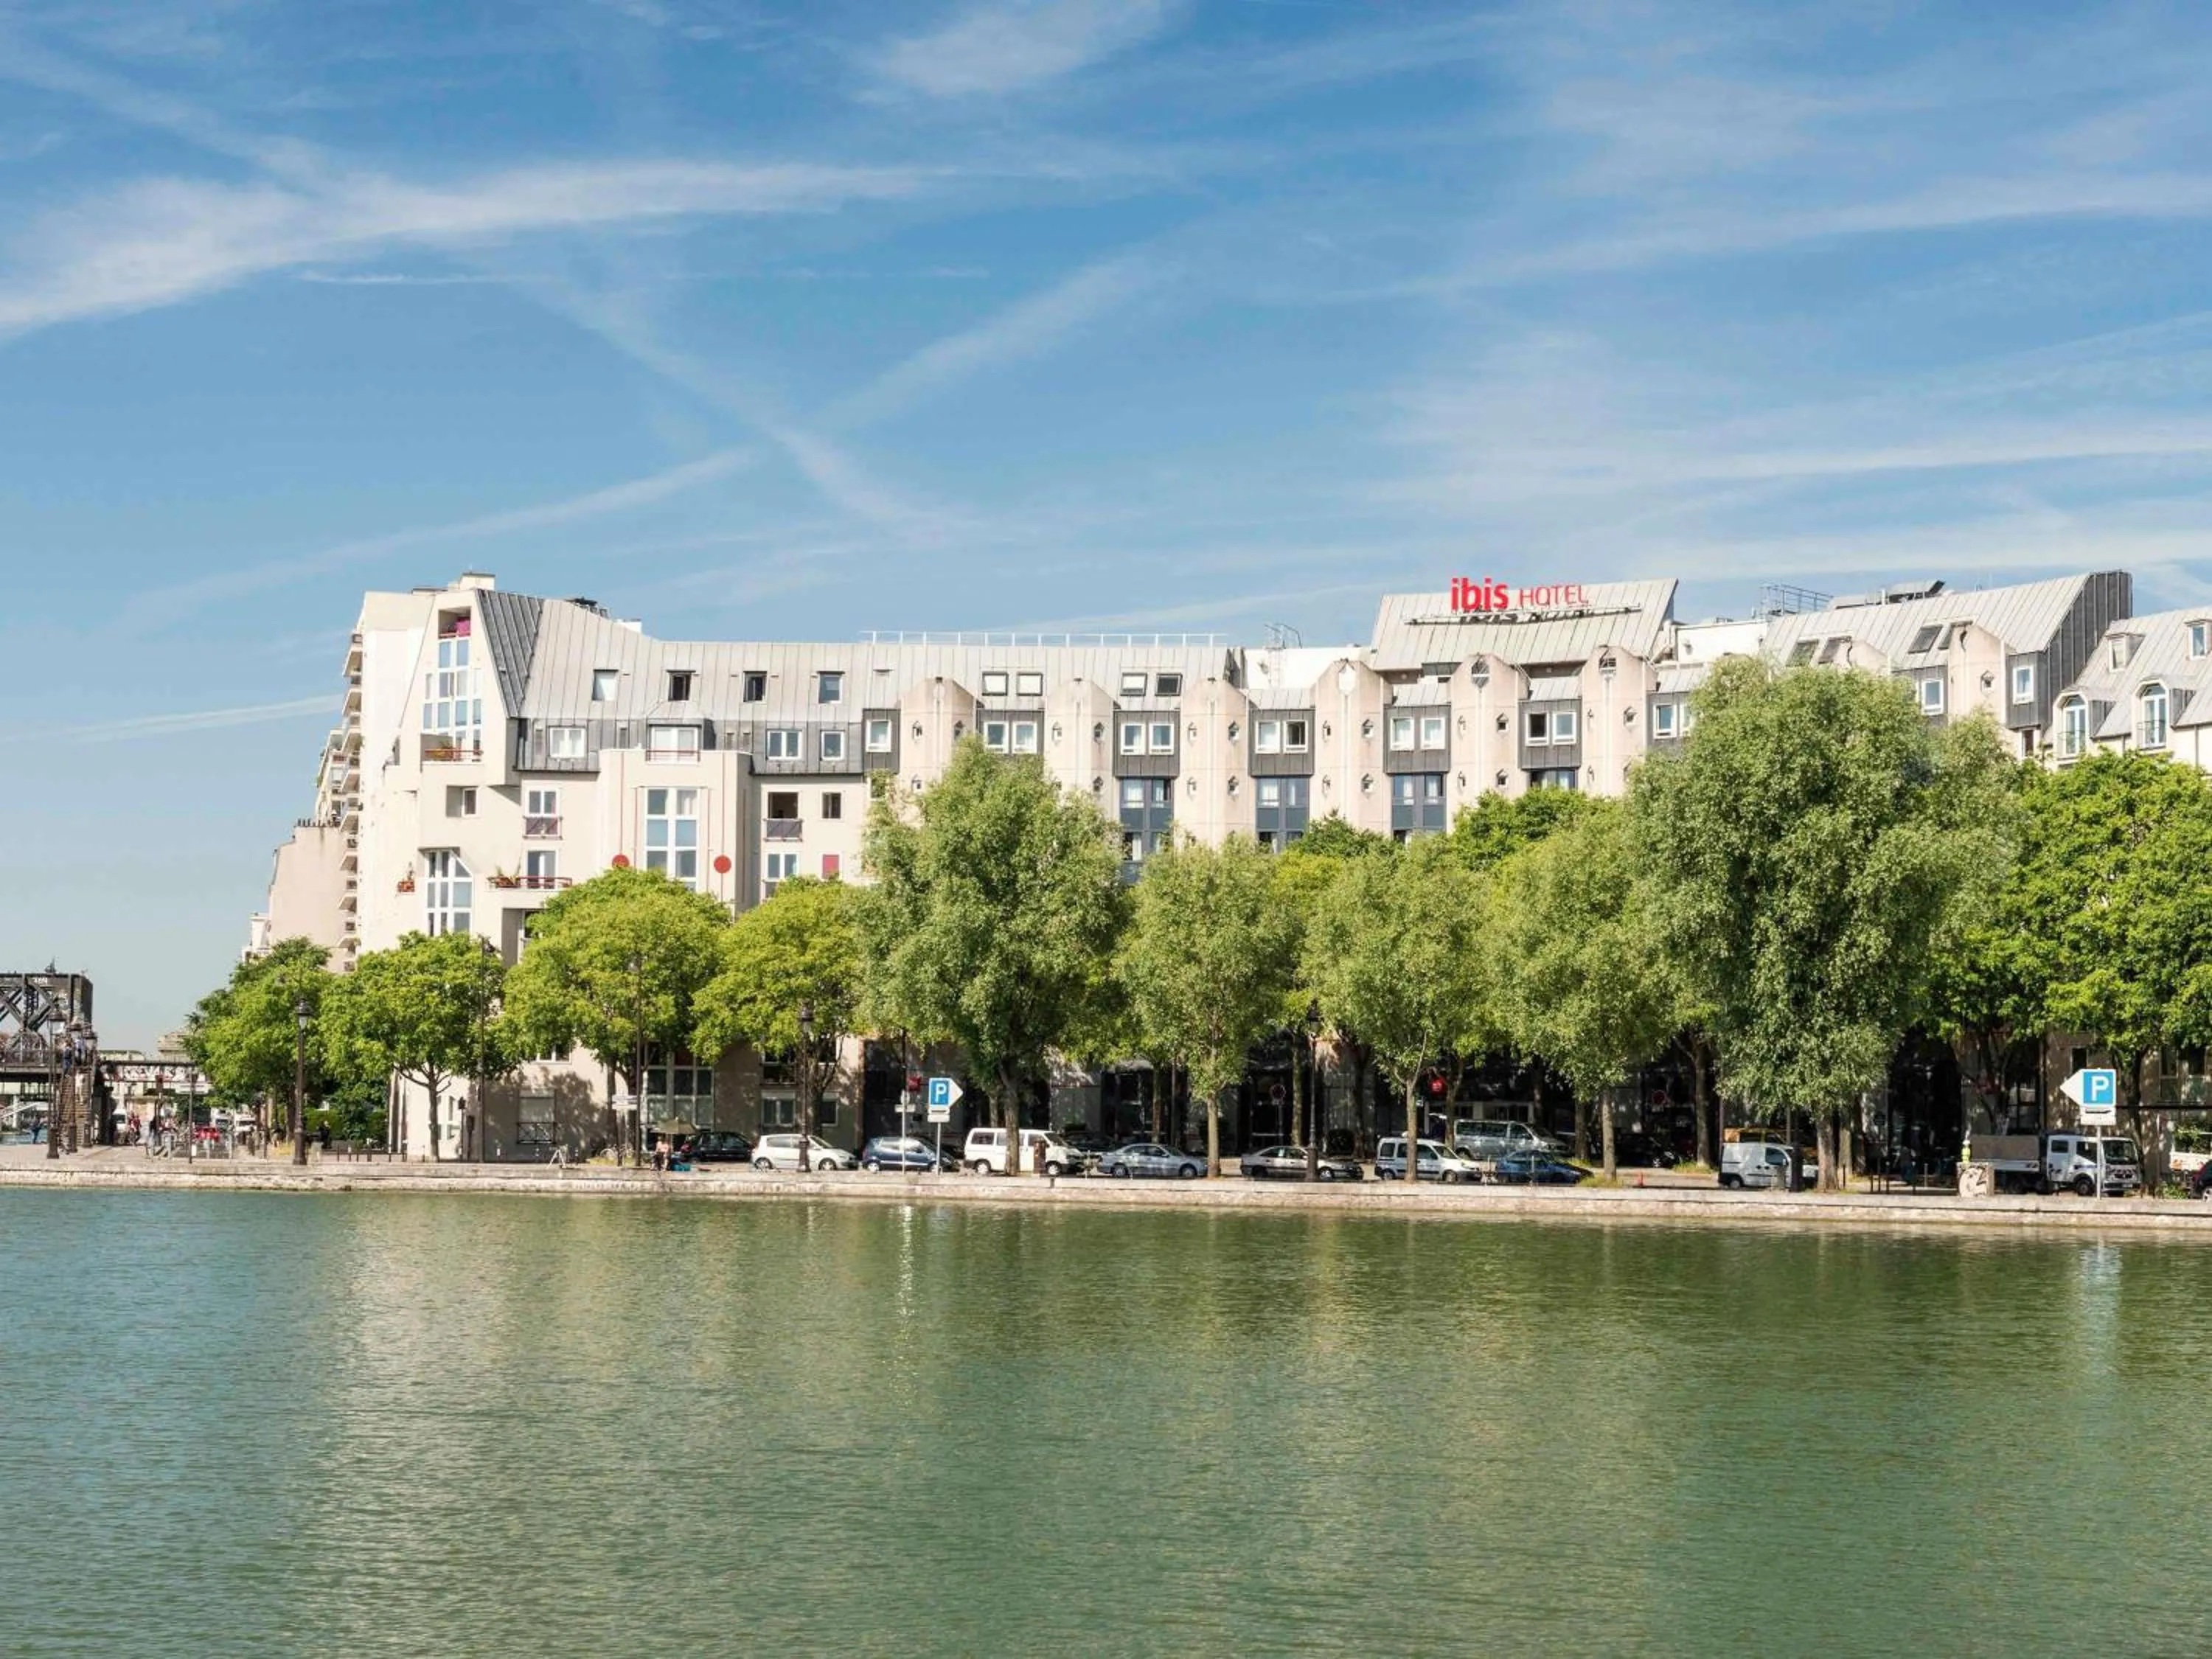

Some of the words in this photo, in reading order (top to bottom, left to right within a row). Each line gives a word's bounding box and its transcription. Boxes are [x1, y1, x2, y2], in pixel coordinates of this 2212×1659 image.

[1451, 577, 1509, 611] ibis
[1519, 585, 1589, 607] HOTEL
[936, 1083, 947, 1103] P
[2091, 1076, 2110, 1102] P
